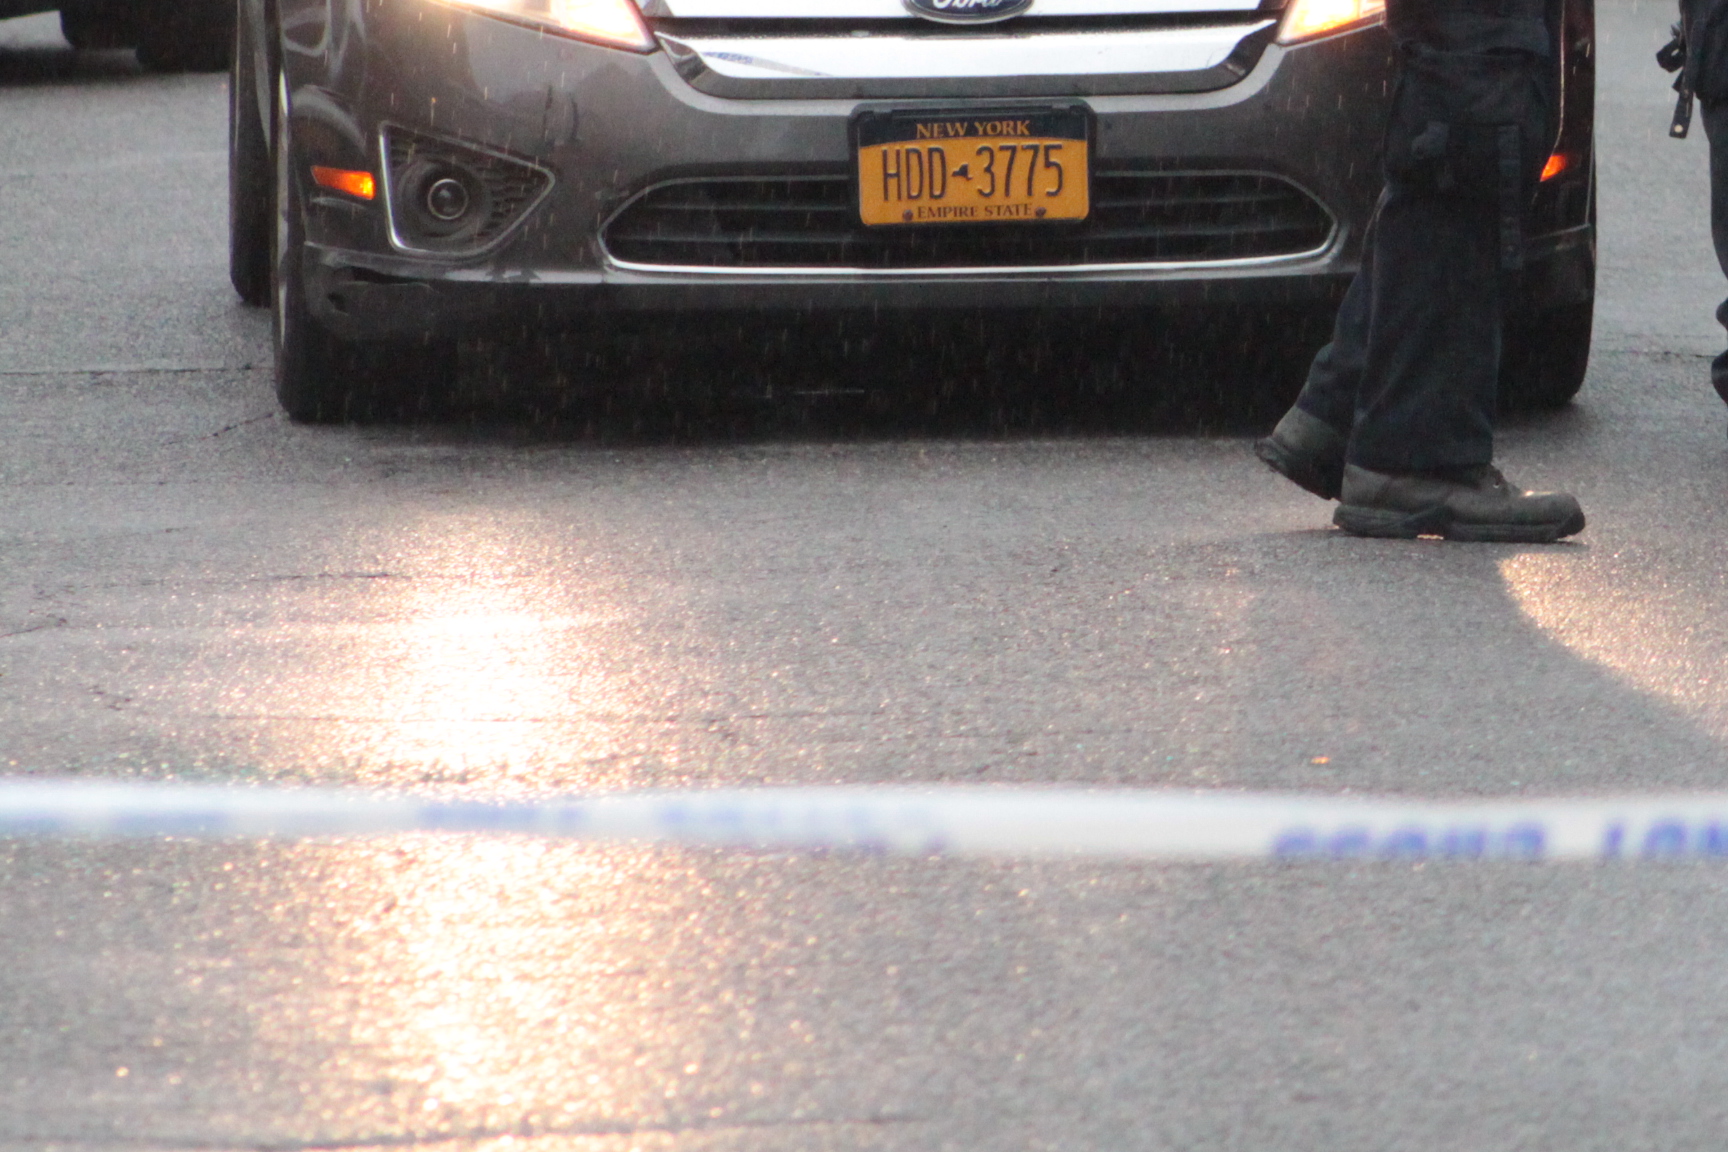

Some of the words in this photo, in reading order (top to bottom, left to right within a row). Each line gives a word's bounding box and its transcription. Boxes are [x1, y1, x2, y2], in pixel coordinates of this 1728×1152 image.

[915, 122, 968, 139] NEW
[974, 120, 1031, 137] YORK
[917, 205, 978, 219] EMPIRE
[984, 203, 1033, 218] STATE
